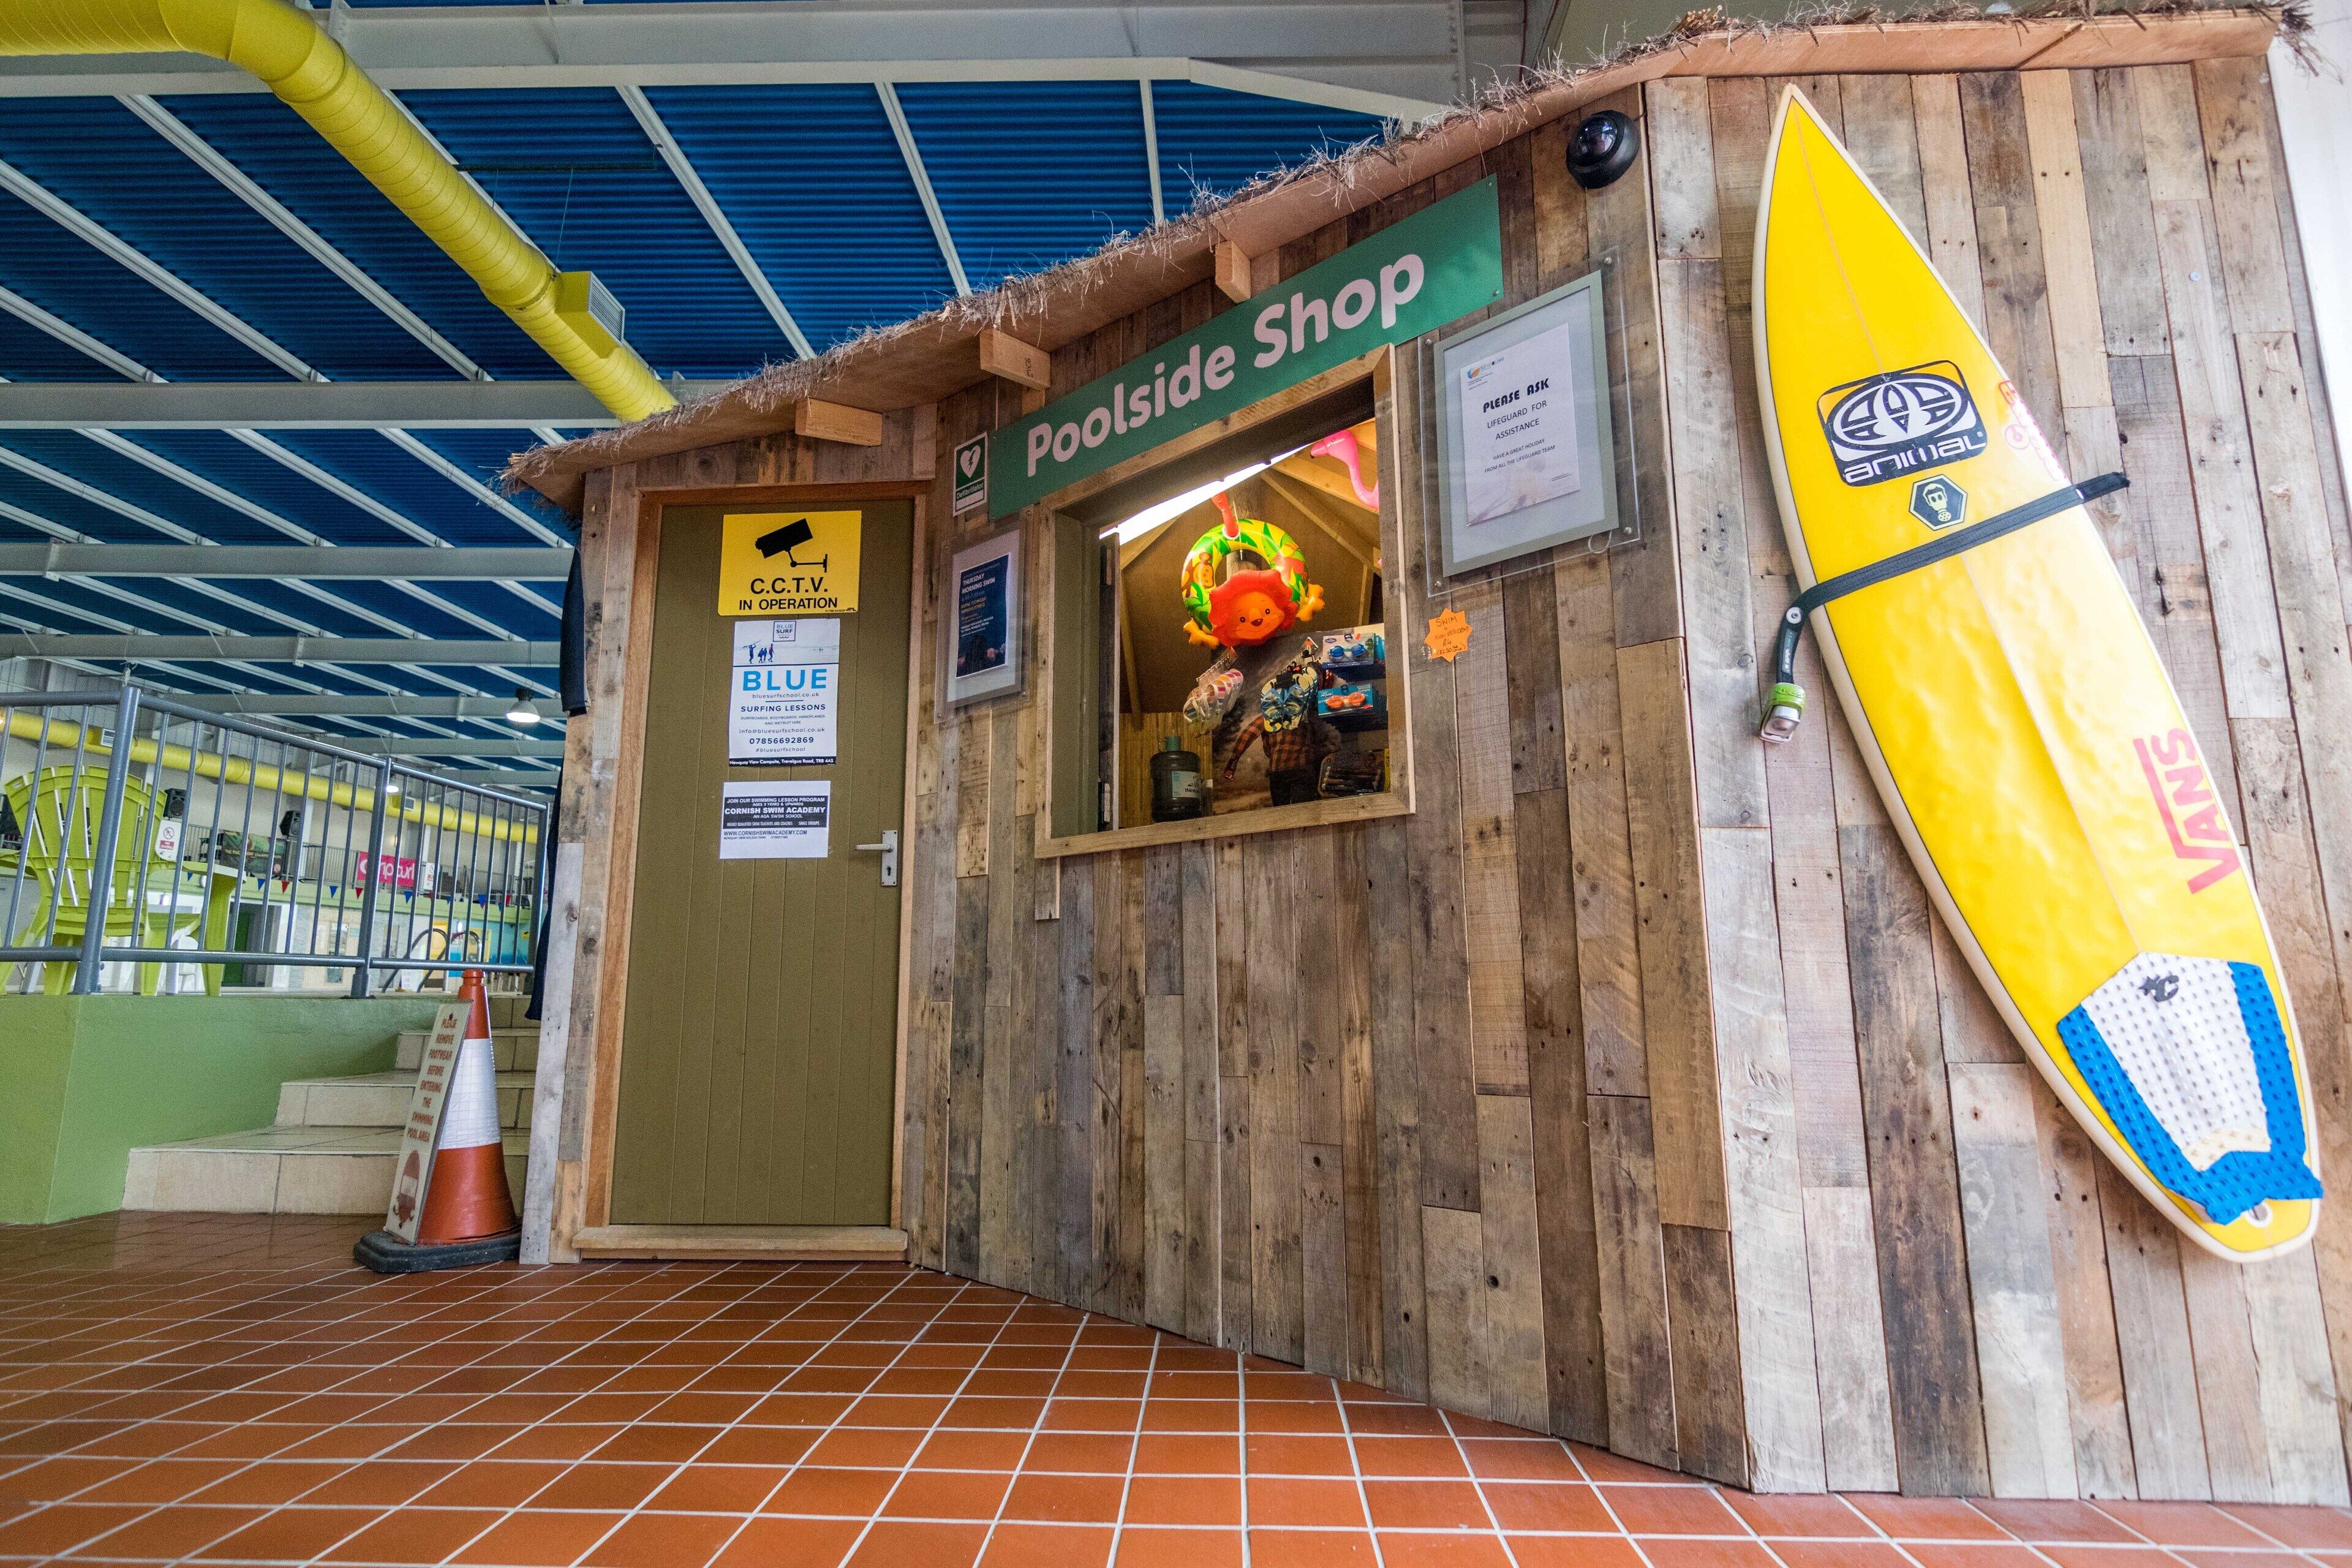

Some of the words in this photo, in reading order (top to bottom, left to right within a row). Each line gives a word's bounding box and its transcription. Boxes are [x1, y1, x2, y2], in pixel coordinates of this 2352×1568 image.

[1027, 344, 1236, 477] Poolside
[1253, 253, 1425, 369] Shop
[1483, 390, 1520, 413] PLEASE
[1527, 378, 1549, 396] ASK
[1487, 408, 1528, 429] LIFEGUARD
[1532, 400, 1547, 411] FOR
[1496, 418, 1539, 440] ASSISTANCE
[1509, 446, 1524, 454] GREAT
[1525, 439, 1545, 449] HOLIDAY
[1516, 450, 1541, 462] LIFEGUARD
[1542, 445, 1555, 453] TEAM
[956, 483, 984, 499] Defibrillator
[750, 577, 827, 595] C.C.T.V.
[962, 581, 982, 594] MORNING
[983, 577, 995, 587] SWIM
[963, 573, 984, 586] THURSDAY
[739, 600, 752, 610] IN
[759, 597, 837, 610] OPERATION
[1436, 616, 1457, 627] SWIM
[1447, 626, 1469, 636] RESIDENT
[742, 669, 827, 691] BLUE
[2133, 728, 2241, 894] VANS
[429, 1049, 453, 1060] FOOTWEAR
[428, 1065, 444, 1076] BEFORE
[420, 1080, 442, 1093] ENTERING
